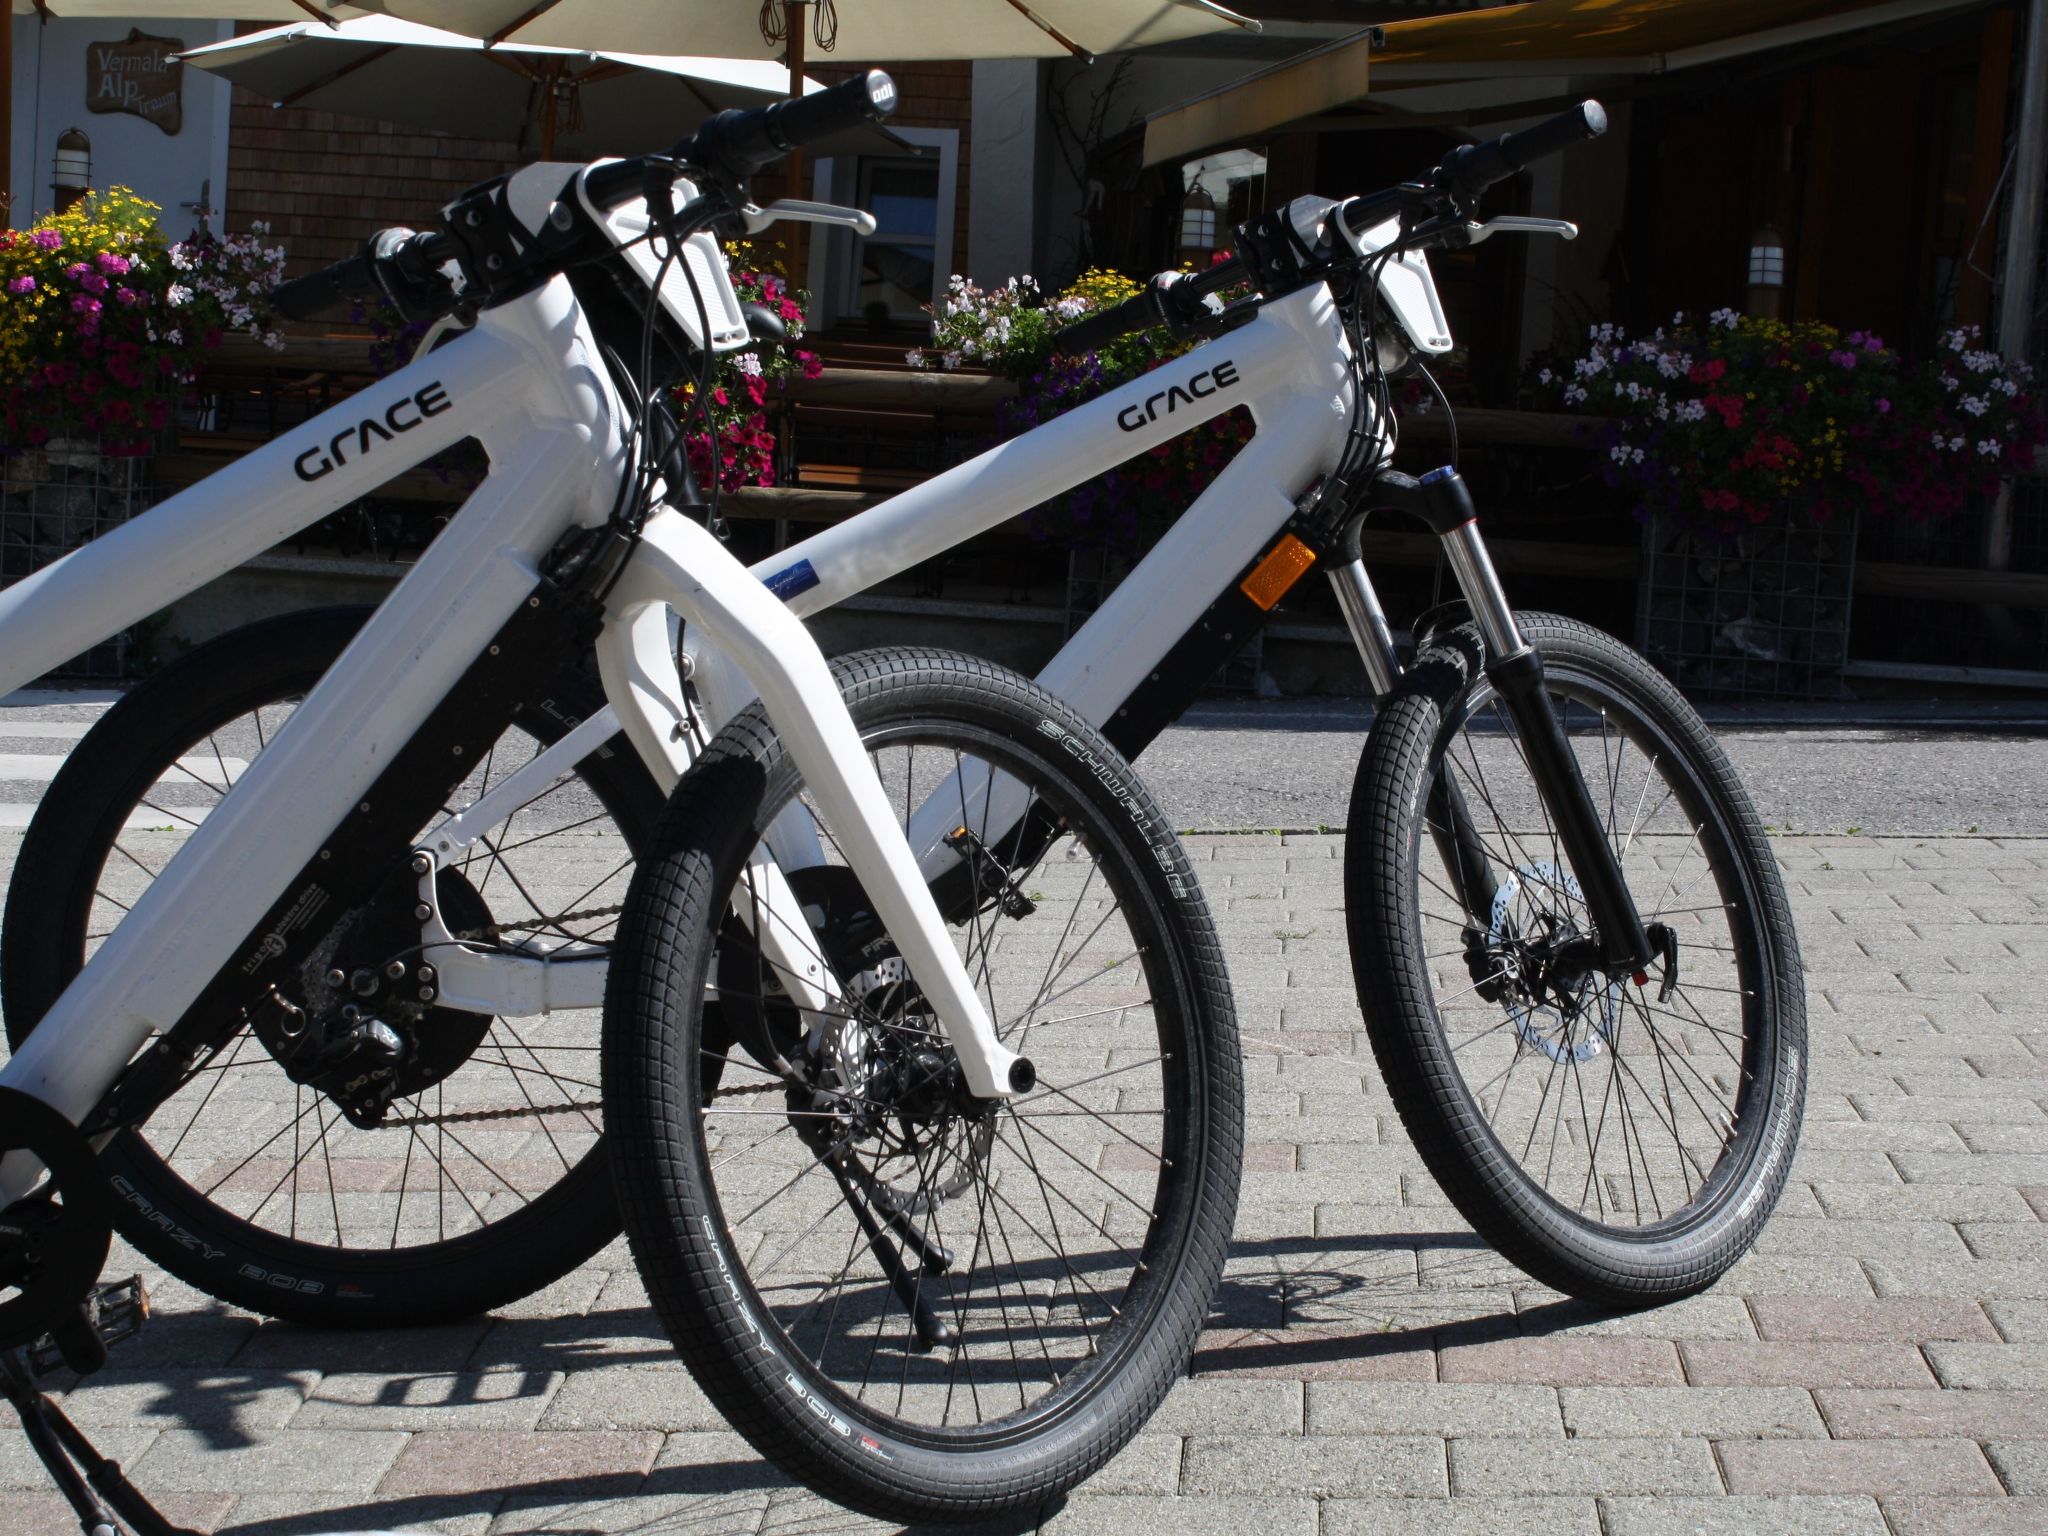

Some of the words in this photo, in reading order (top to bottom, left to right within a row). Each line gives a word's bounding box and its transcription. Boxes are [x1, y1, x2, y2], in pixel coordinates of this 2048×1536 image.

[98, 72, 139, 107] Alp
[294, 380, 453, 482] GRACE
[1117, 360, 1240, 432] GRACE
[1037, 719, 1187, 899] SCHWALBE
[1739, 1046, 1799, 1219] SCHWALBE
[110, 1174, 226, 1260] CRAZY
[239, 1264, 324, 1294] BOB
[703, 1215, 775, 1355] CRAZY
[785, 1373, 851, 1436] BOB
